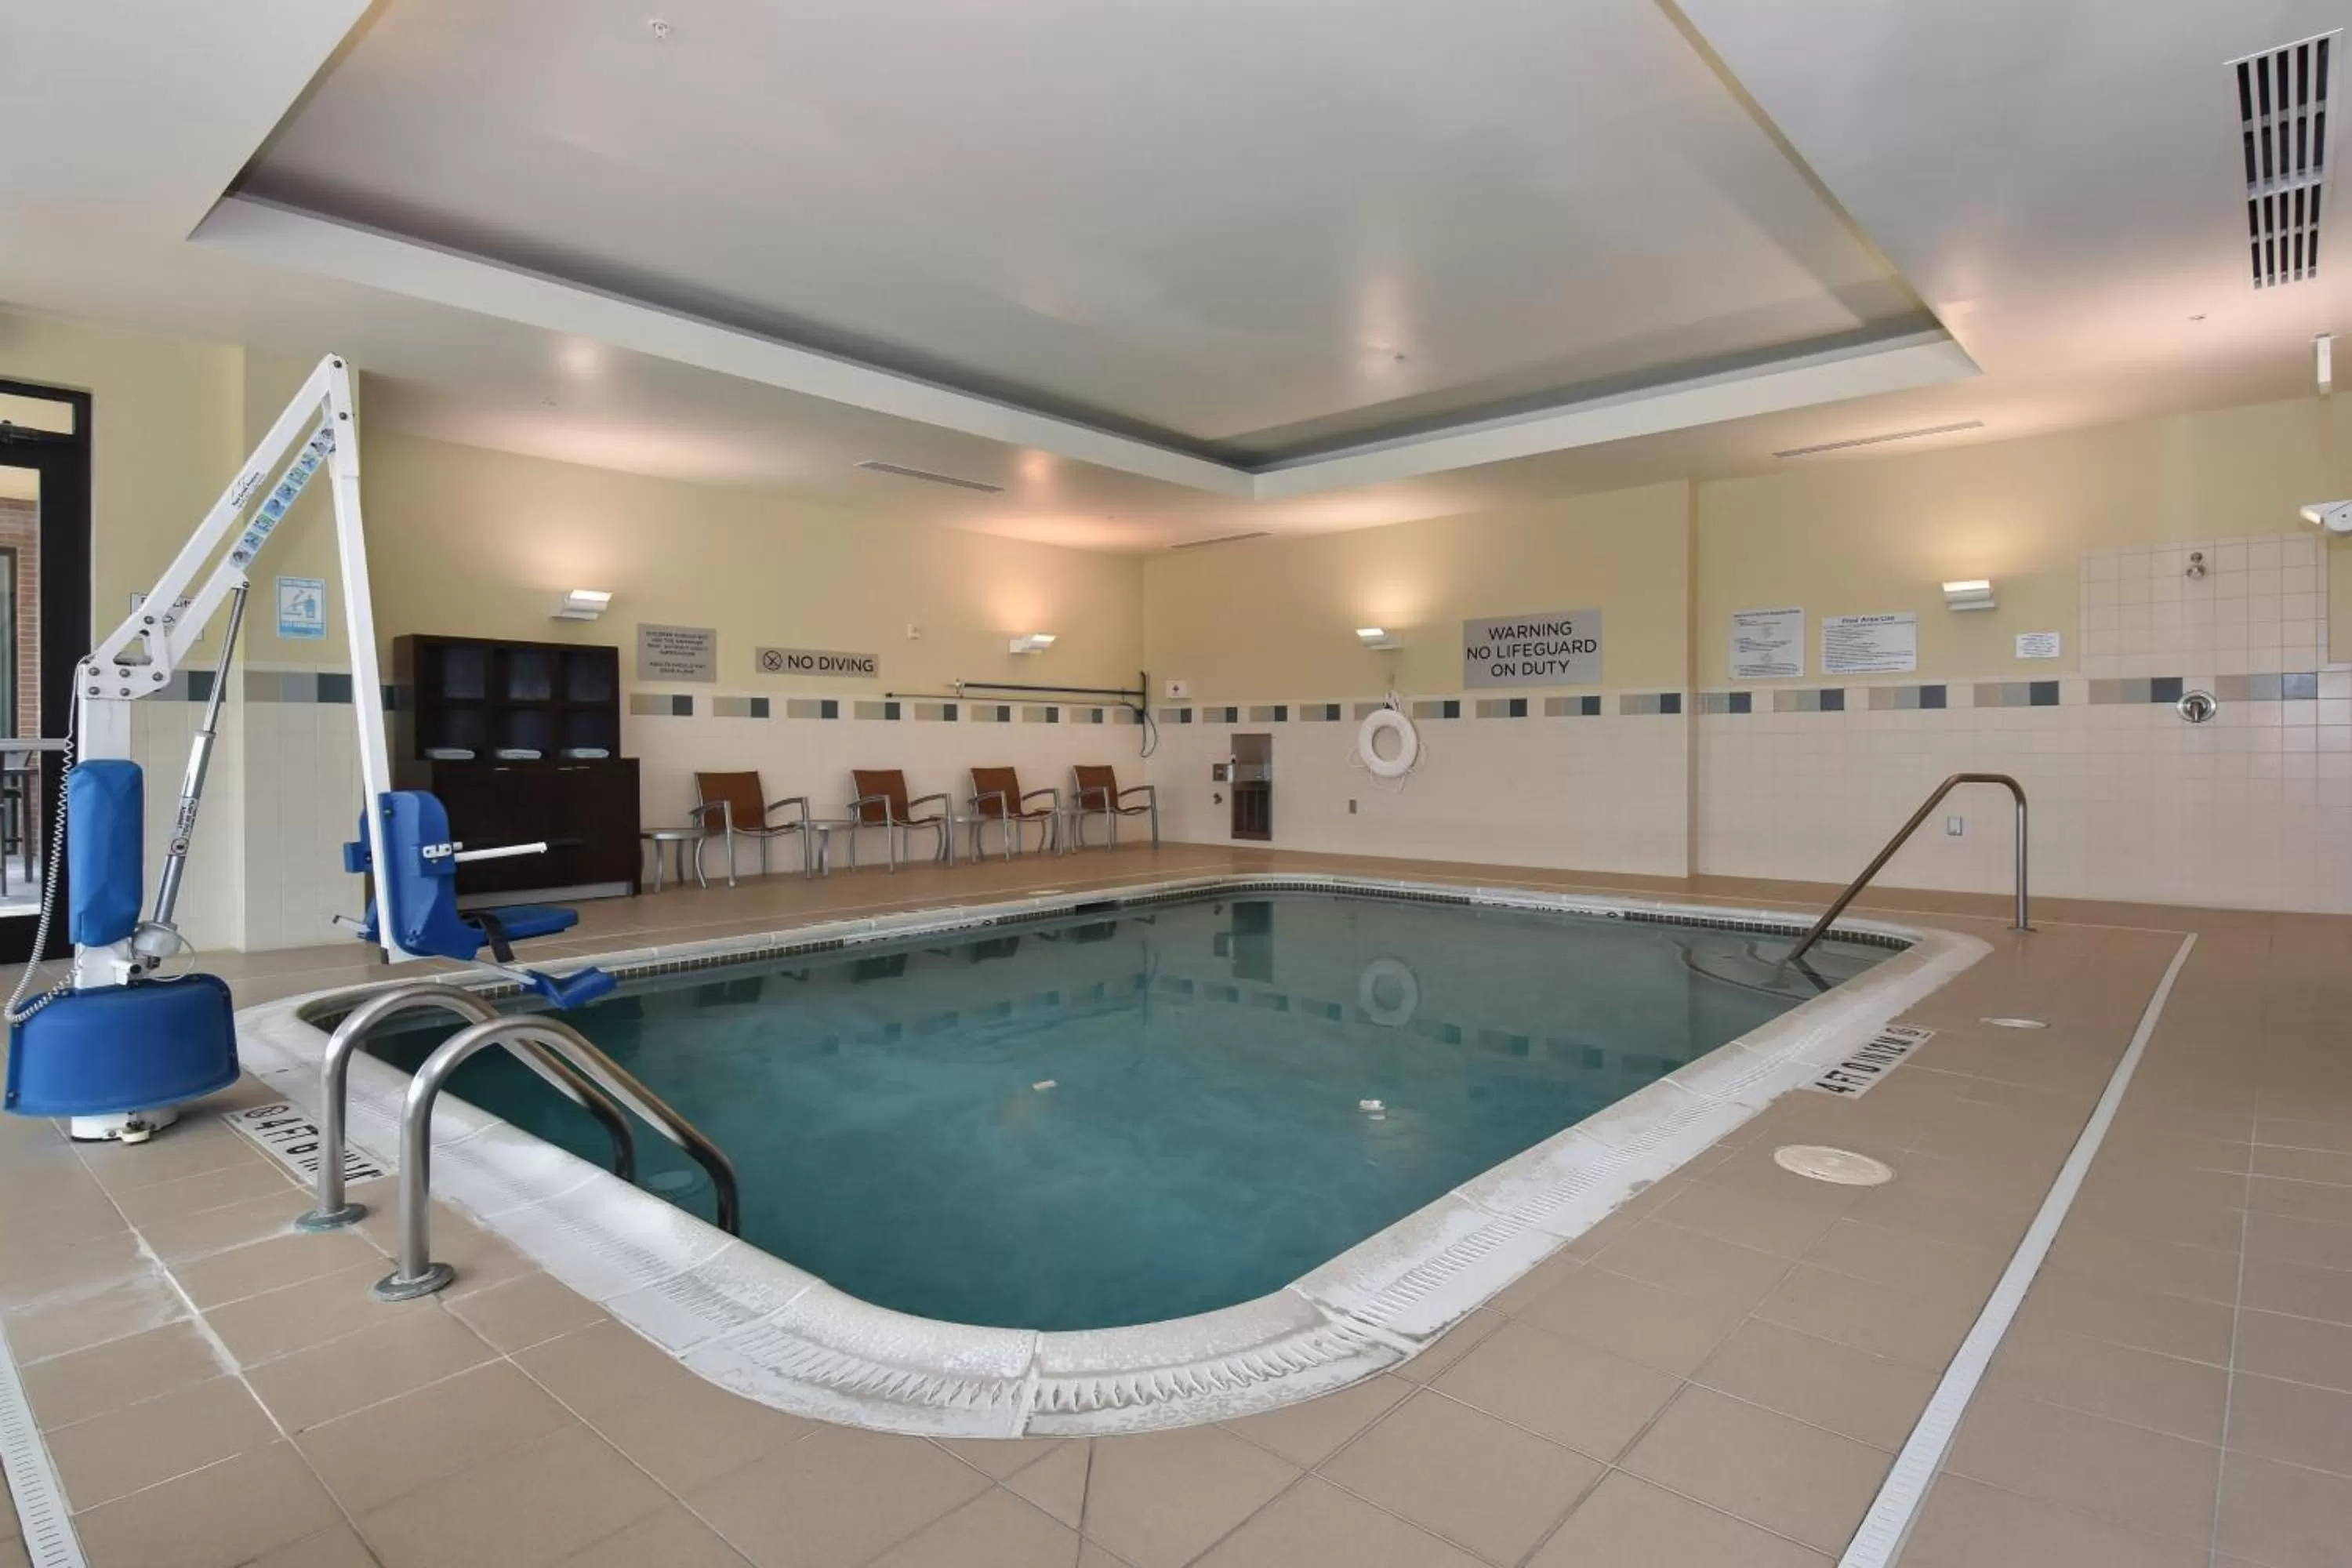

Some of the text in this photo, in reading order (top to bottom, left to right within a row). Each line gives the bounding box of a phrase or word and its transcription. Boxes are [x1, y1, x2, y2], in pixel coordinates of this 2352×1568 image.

[1488, 621, 1573, 641] WARNING
[1466, 639, 1598, 661] NO LIFEGUARD
[787, 655, 874, 673] NO DIVING
[1490, 659, 1570, 677] ON DUTY
